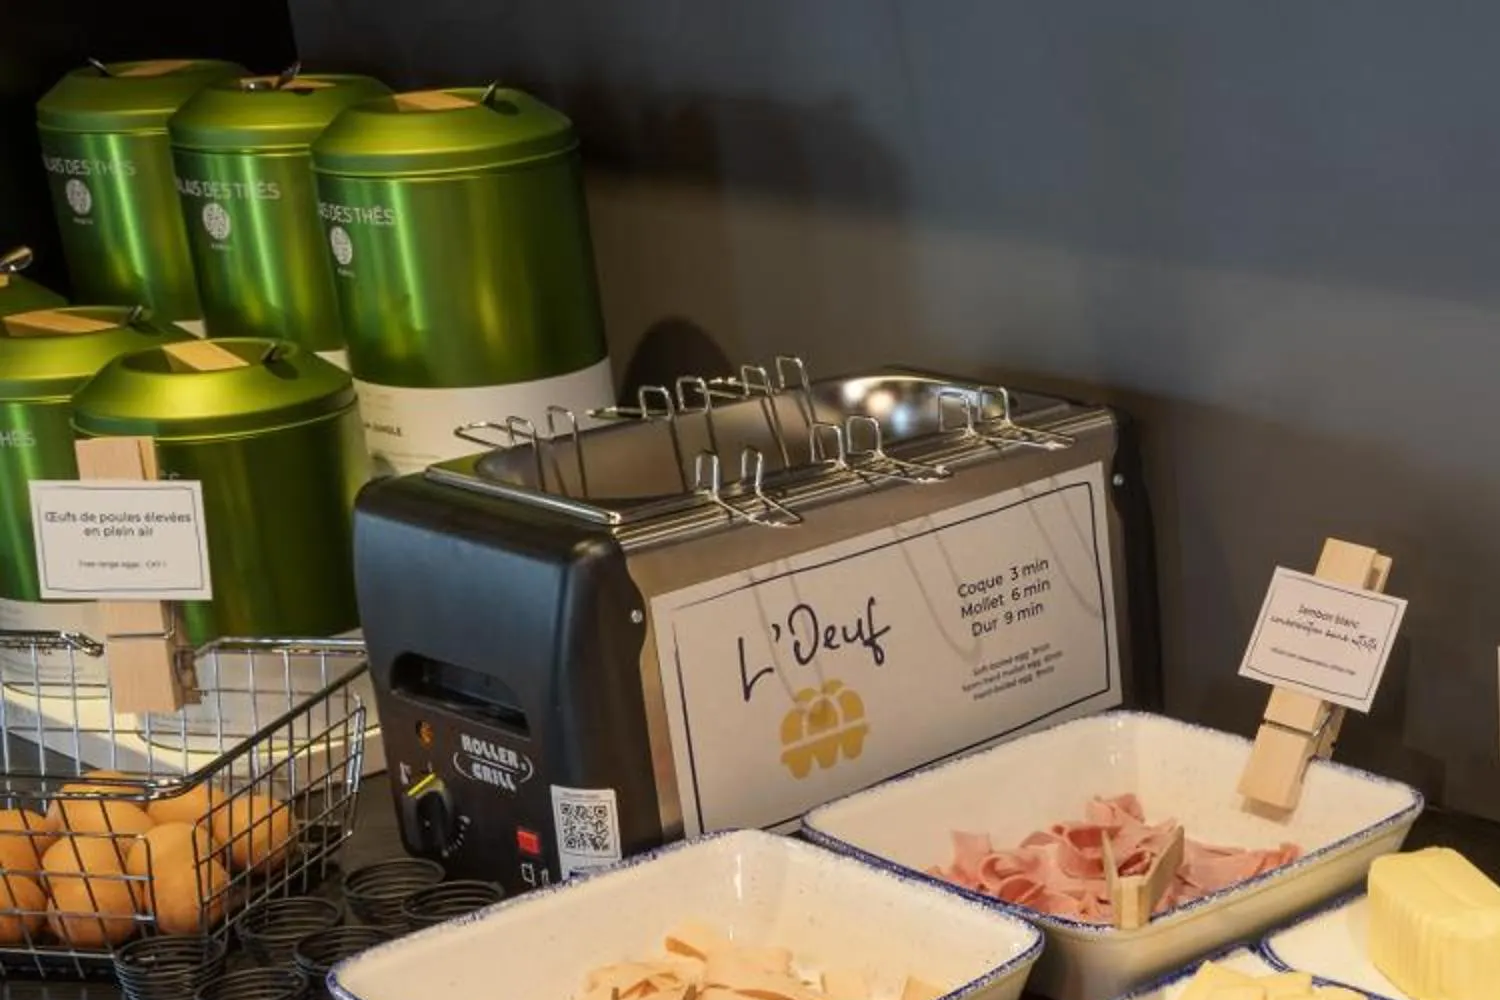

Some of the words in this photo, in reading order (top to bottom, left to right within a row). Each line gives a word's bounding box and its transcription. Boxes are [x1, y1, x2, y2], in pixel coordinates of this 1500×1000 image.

[80, 511, 97, 523] de
[99, 511, 142, 525] poules
[144, 511, 192, 523] élevées
[83, 526, 100, 537] en
[103, 525, 135, 538] plein
[138, 525, 153, 537] air
[957, 575, 1004, 599] Coque
[1009, 566, 1019, 581] 3
[1021, 559, 1049, 576] min
[960, 594, 1004, 619] Mollet
[1011, 587, 1021, 602] 6
[1023, 579, 1051, 598] min
[971, 618, 997, 637] Dur
[1004, 610, 1014, 625] 9
[1017, 602, 1044, 621] min
[461, 733, 519, 769] ROLLER
[471, 762, 516, 791] GRILL
